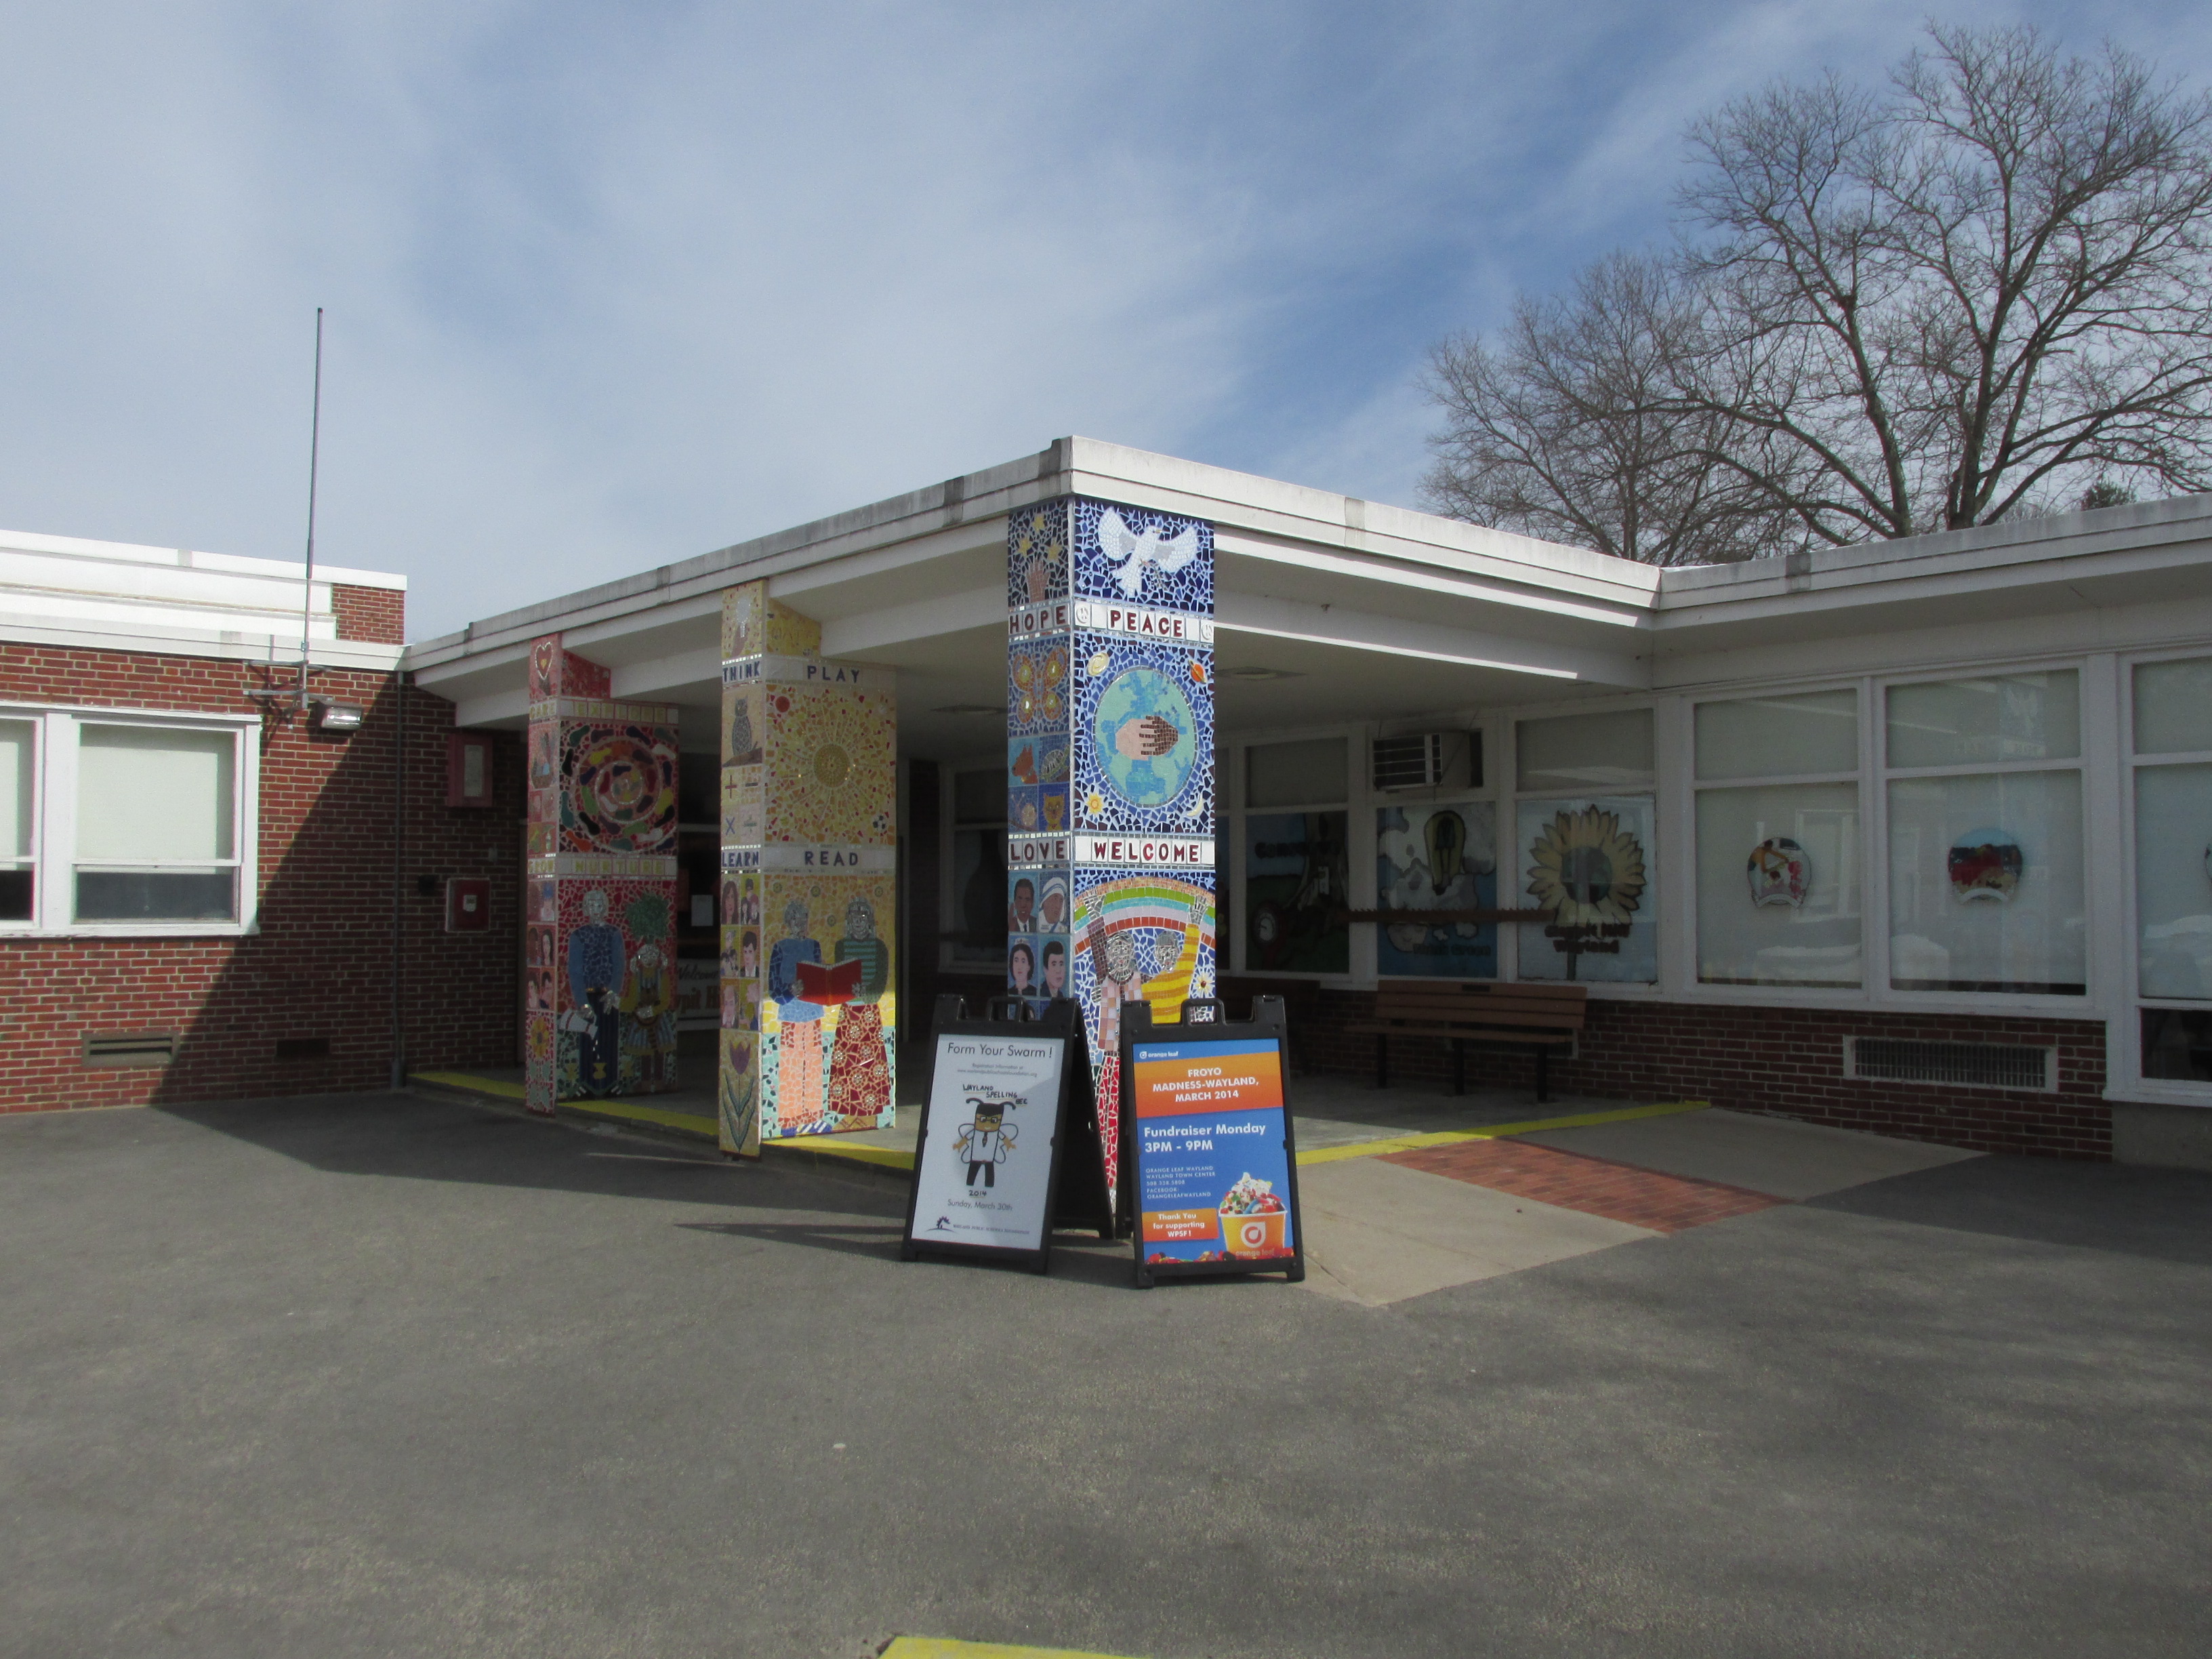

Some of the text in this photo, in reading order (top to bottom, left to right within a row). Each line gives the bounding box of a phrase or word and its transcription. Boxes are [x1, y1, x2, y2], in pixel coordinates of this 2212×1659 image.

[1009, 605, 1184, 637] HOPE PEACE
[722, 661, 861, 684] THINK PLAY
[1010, 840, 1200, 863] LOVE WELCOME
[722, 851, 859, 867] LEARN READ
[947, 1042, 976, 1054] Form
[980, 1043, 1004, 1056] Your
[1007, 1044, 1046, 1058] Swarm
[1187, 1067, 1222, 1078] FROYO
[962, 1084, 994, 1092] WAYLAND
[1153, 1077, 1259, 1092] MADNESS-WAYLAND,
[1175, 1090, 1240, 1103] MARCH 2014
[1143, 1122, 1266, 1138] Fundraiser Monday
[1145, 1141, 1173, 1153] 3PM
[1185, 1140, 1213, 1151] 9PM
[1147, 1191, 1212, 1200] ORANGELEAFWAYLAND
[947, 1198, 1013, 1212] Sunday, March 30th
[1165, 1221, 1205, 1231] supporting
